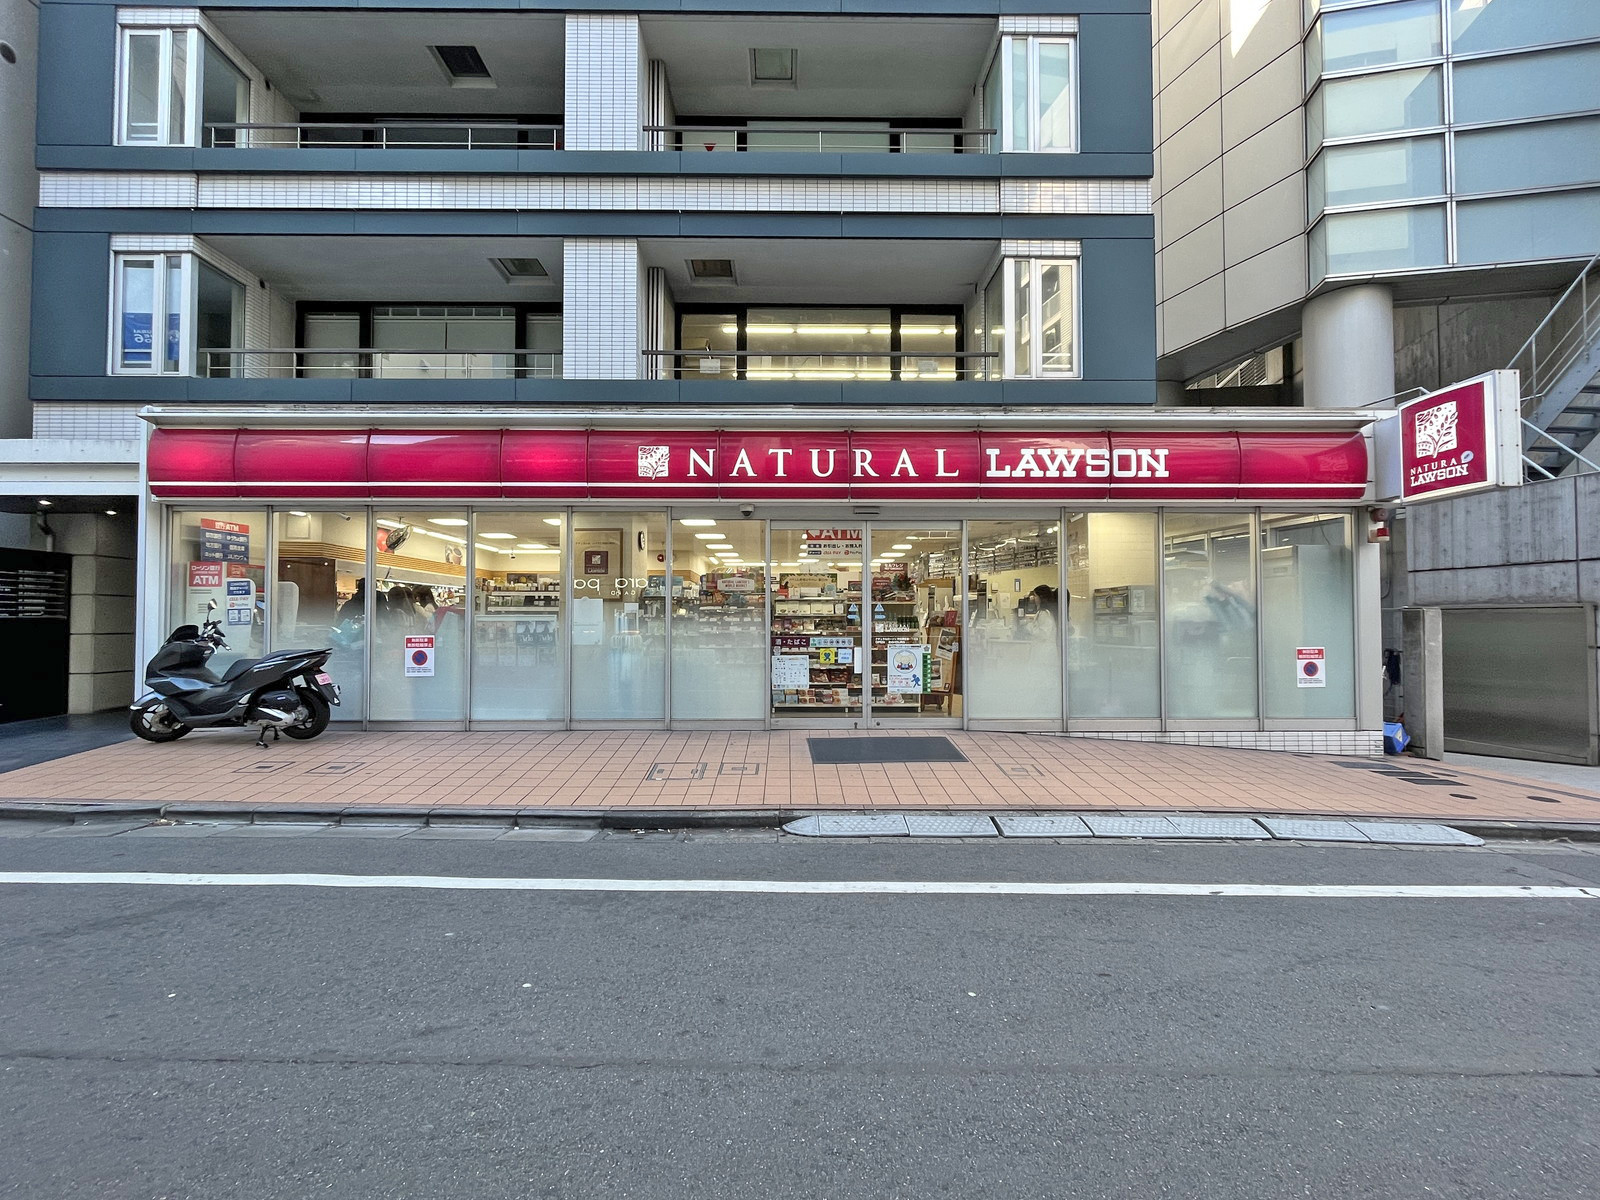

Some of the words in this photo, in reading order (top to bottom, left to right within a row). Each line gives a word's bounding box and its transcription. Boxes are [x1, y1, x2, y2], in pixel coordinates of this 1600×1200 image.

[687, 448, 960, 477] NATURAL
[986, 448, 1169, 478] LAWSON
[1410, 458, 1459, 476] NATURA
[1410, 463, 1469, 488] LAWSON
[193, 575, 219, 585] ATM
